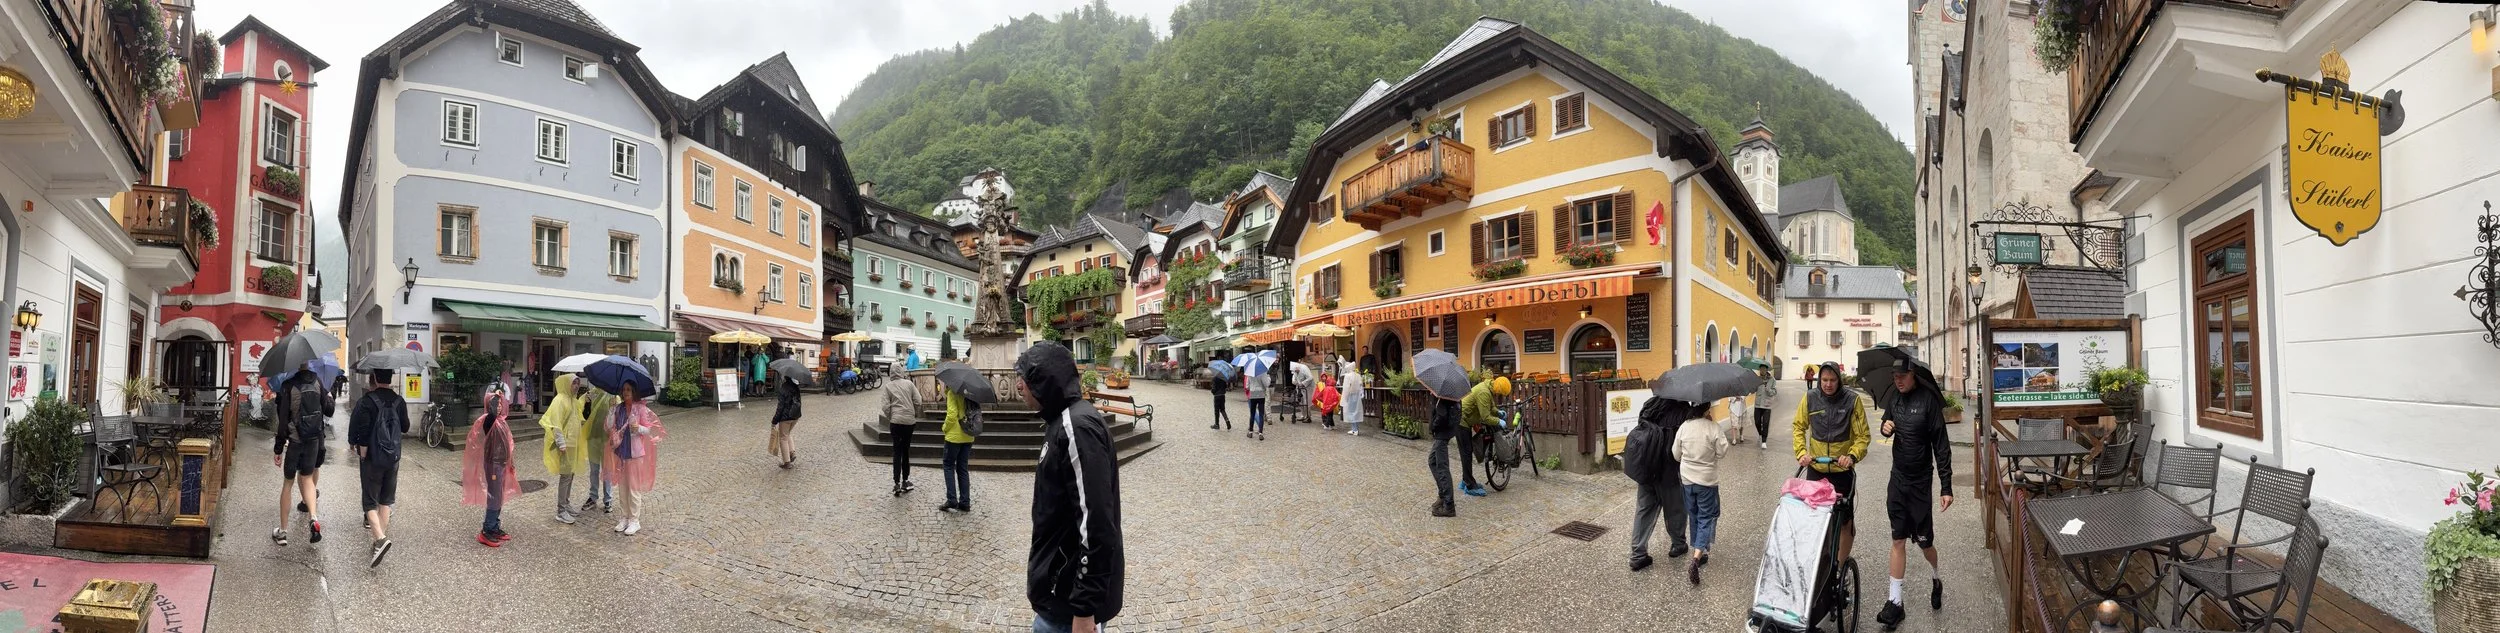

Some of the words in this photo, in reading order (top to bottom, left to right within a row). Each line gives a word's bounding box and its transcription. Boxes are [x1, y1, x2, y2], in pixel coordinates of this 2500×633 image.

[2297, 127, 2373, 161] Kaiser
[2295, 179, 2377, 210] Stüberl
[1999, 237, 2036, 248] Grüner
[2002, 249, 2033, 260] Baum
[1346, 304, 1426, 325] Restaurant
[1451, 293, 1495, 312] Café
[1527, 281, 1600, 303] Derbl
[538, 327, 553, 335] Das
[554, 328, 576, 336] Dirndl
[590, 330, 619, 338] Hallstatt
[1998, 394, 2043, 402] Seeterrasse
[2068, 392, 2085, 400] side
